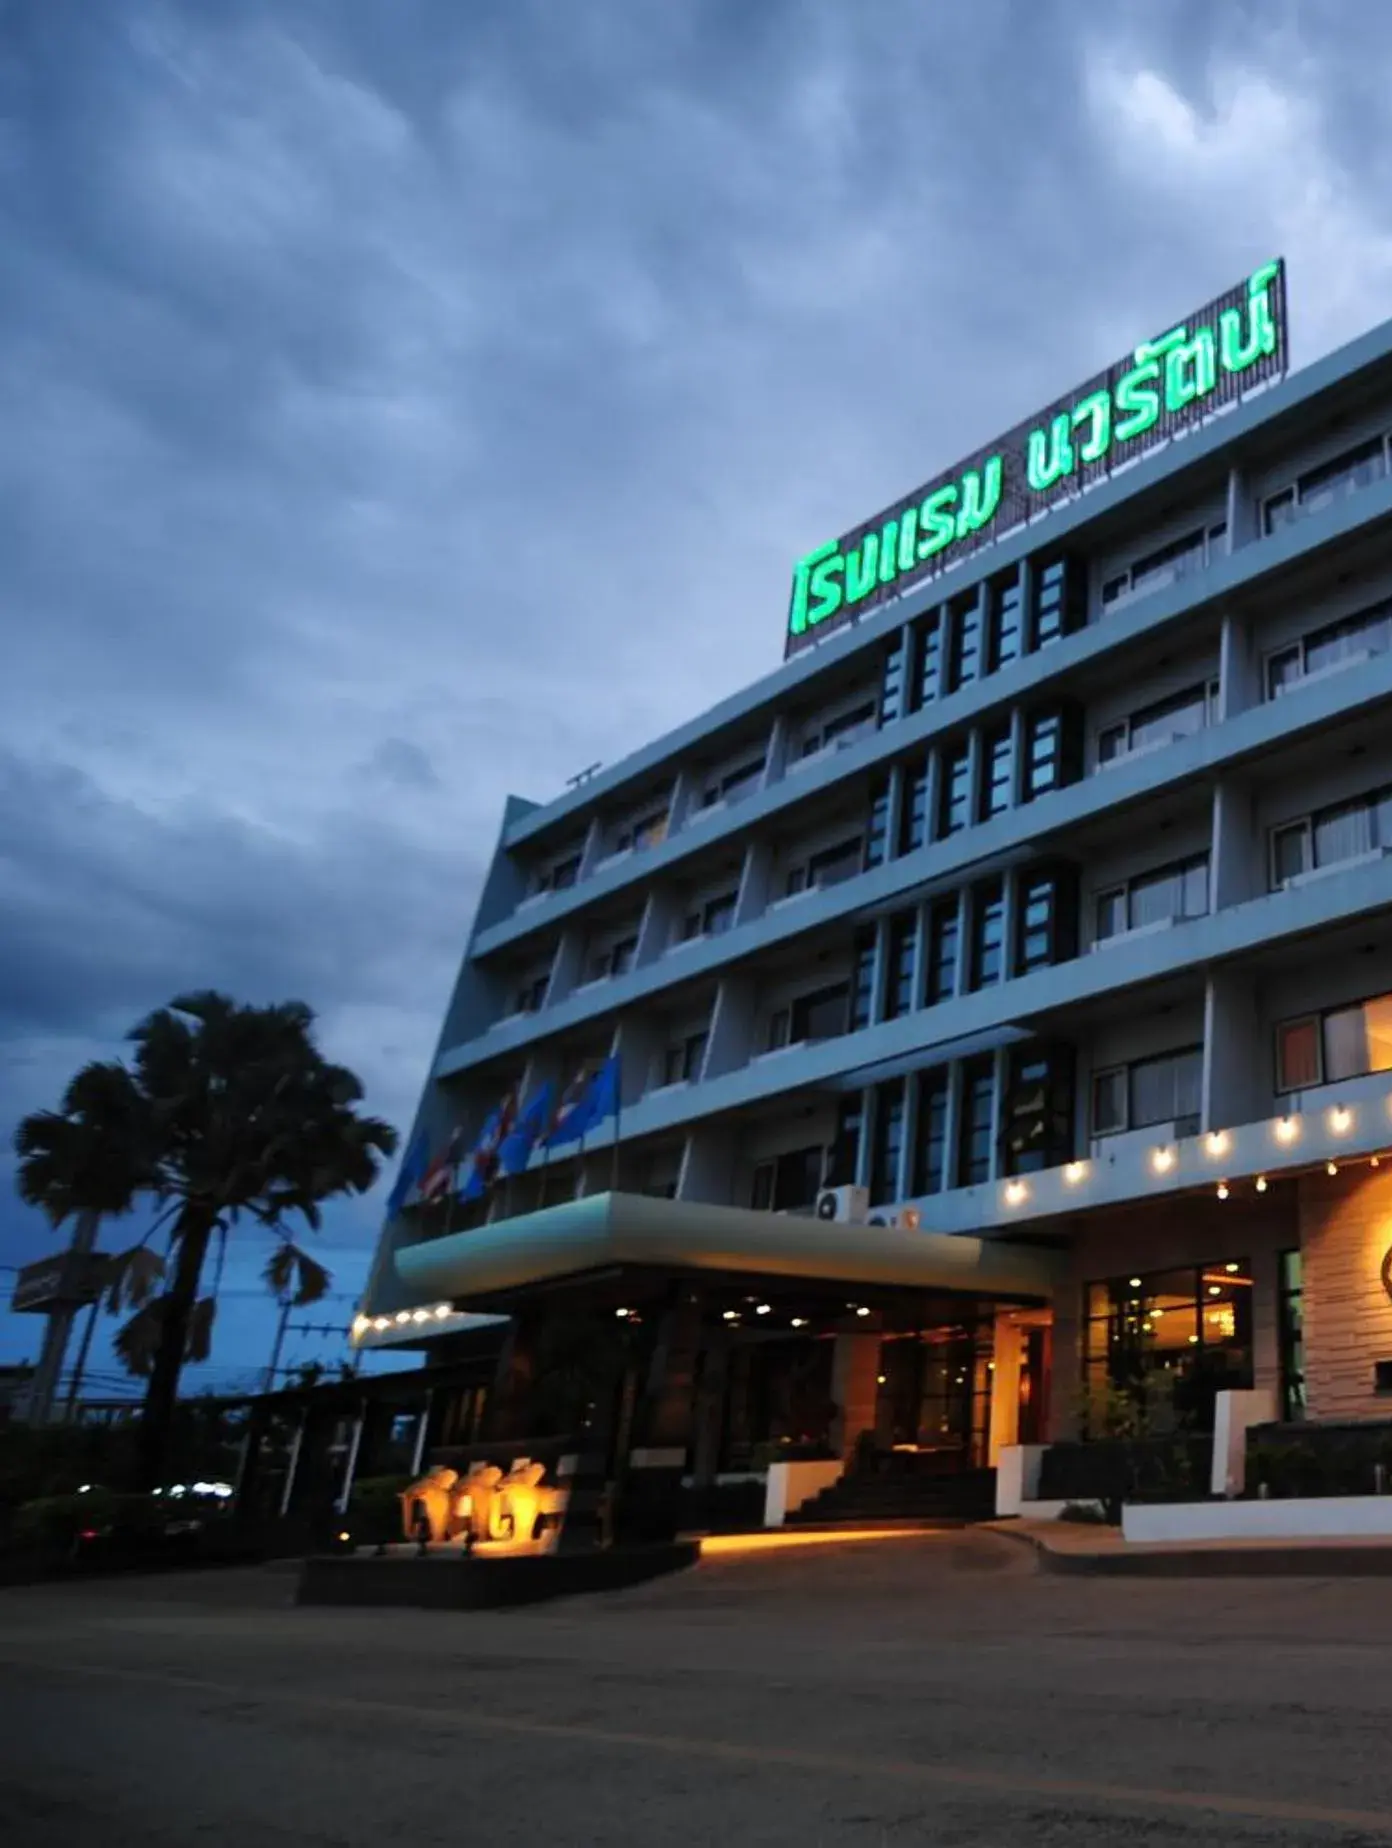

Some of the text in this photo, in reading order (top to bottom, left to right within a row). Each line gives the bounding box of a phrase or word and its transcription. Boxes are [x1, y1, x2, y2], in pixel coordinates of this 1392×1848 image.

[789, 260, 1280, 636] โรงแรม นวรัตน์
